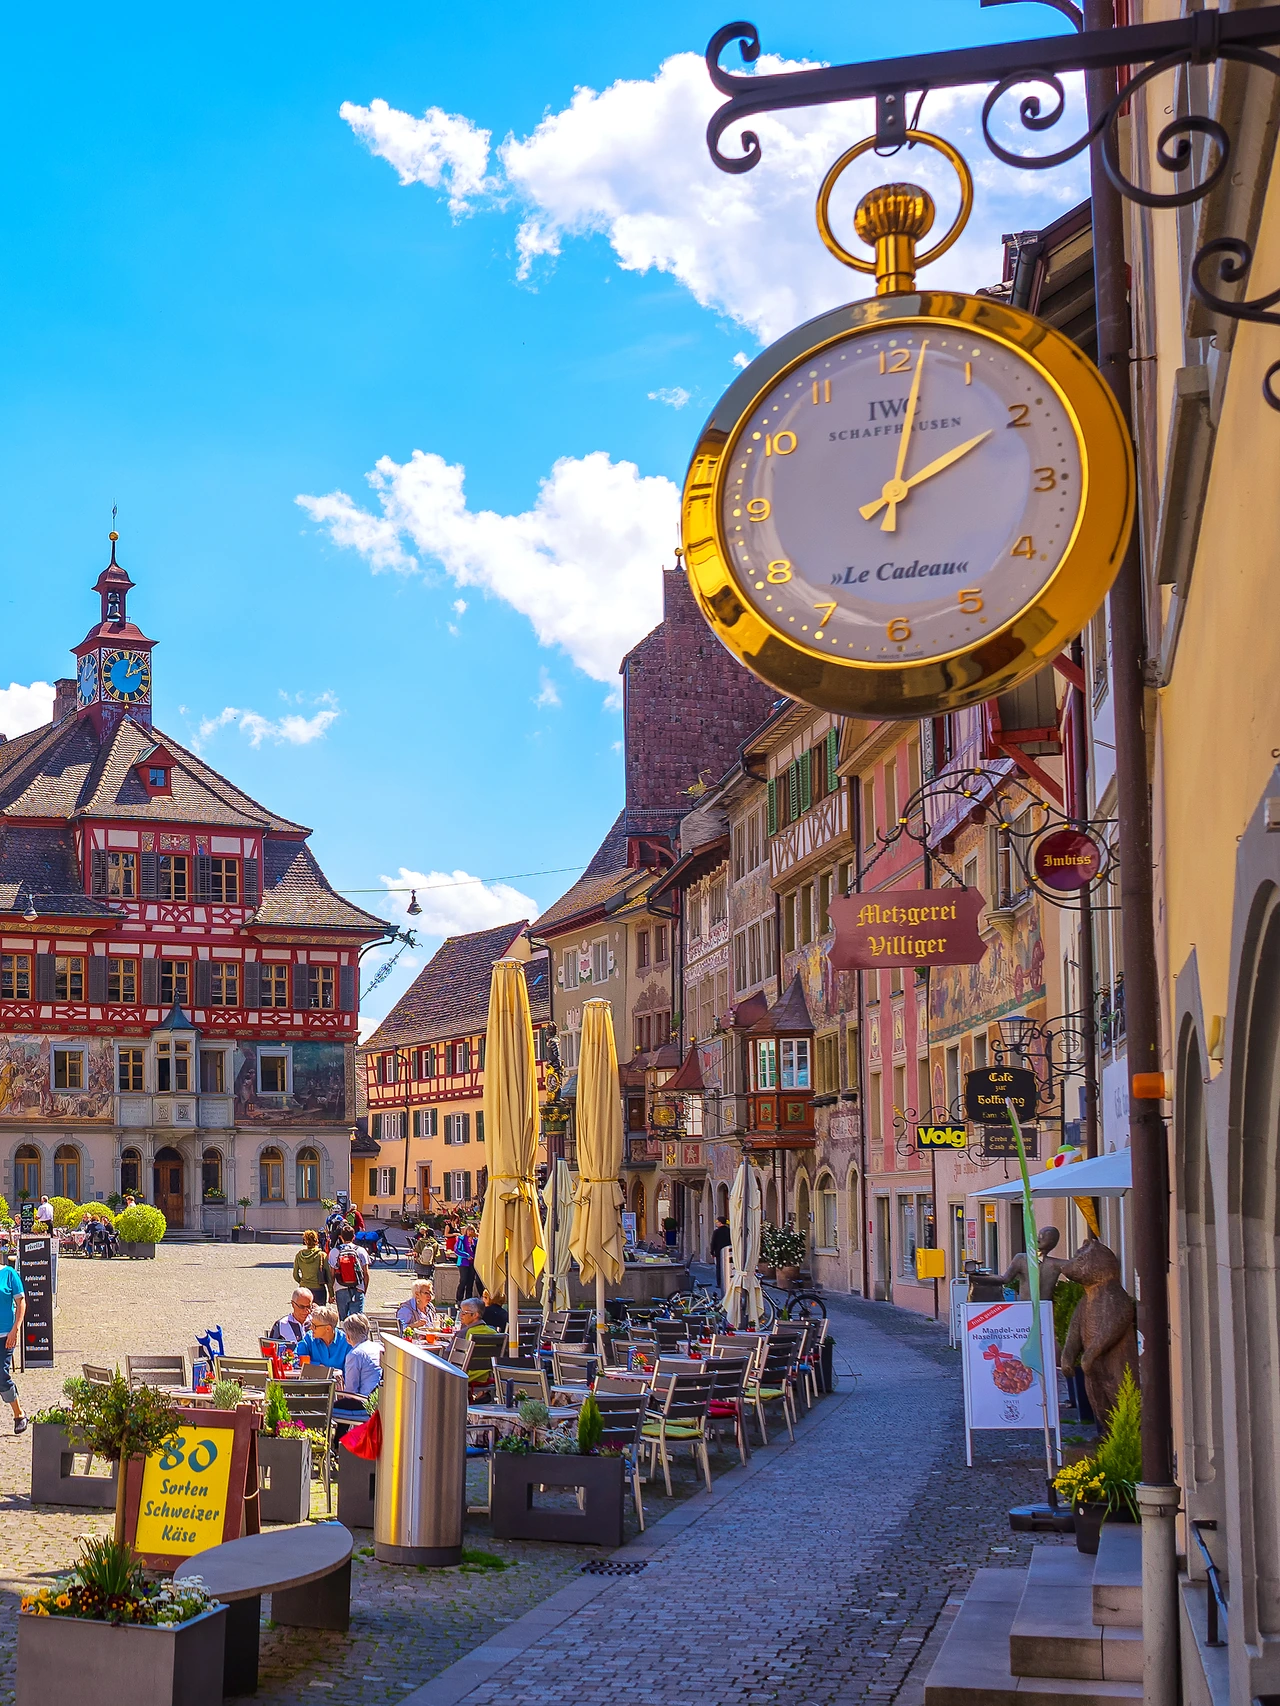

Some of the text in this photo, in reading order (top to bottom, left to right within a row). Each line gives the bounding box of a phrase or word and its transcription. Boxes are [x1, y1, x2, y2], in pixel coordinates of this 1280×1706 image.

[879, 348, 912, 375] 12
[963, 361, 973, 386] 1
[812, 379, 832, 405] 11
[868, 395, 922, 422] IWC
[1006, 404, 1032, 430] 2
[764, 430, 798, 456] 10
[1033, 467, 1057, 492] 3
[745, 498, 771, 523] 9
[1009, 534, 1037, 560] 4
[766, 559, 793, 585] 8
[957, 588, 984, 614] 5
[812, 601, 838, 628] 7
[886, 617, 912, 643] 6
[1043, 854, 1092, 867] Imbiss
[856, 900, 957, 927] Metzgerei
[867, 935, 947, 958] Villiger
[977, 1094, 1025, 1108] Hoffnng
[917, 1127, 967, 1149] Volg
[159, 1436, 218, 1473] 80
[160, 1478, 209, 1497] Sorten
[144, 1500, 220, 1522] Schweizer
[161, 1524, 197, 1543] Käse
